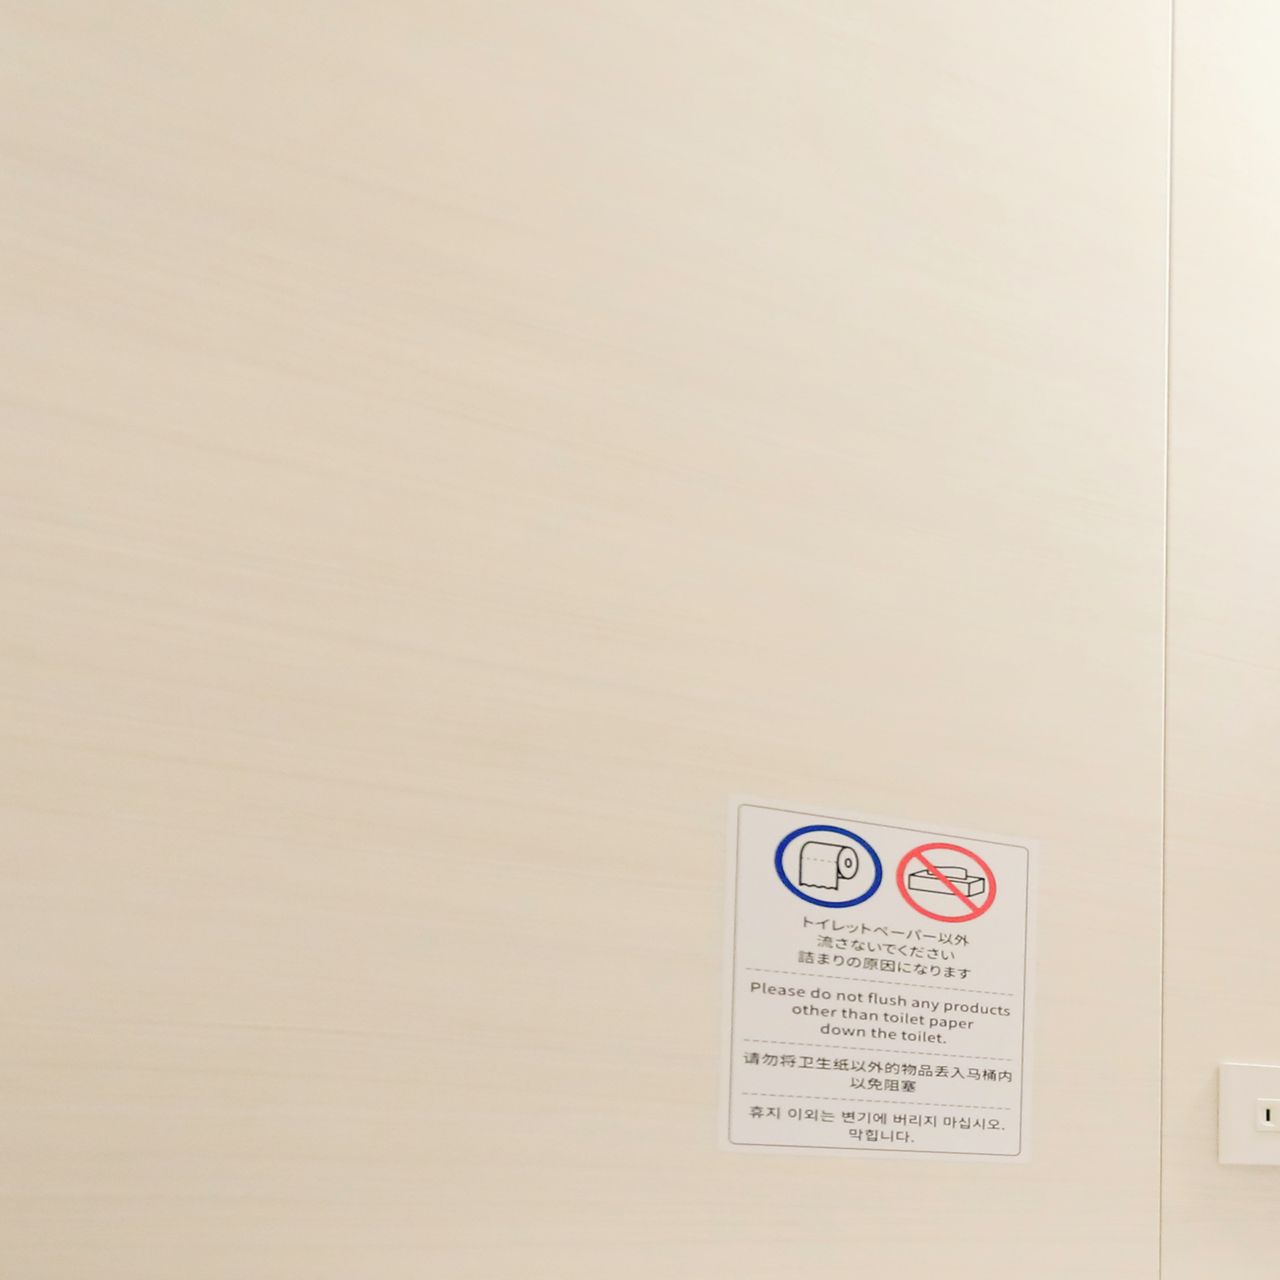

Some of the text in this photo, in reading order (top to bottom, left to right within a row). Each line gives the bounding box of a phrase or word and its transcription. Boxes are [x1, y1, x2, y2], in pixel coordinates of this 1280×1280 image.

[817, 934, 955, 961] 流さないでください
[798, 950, 972, 980] 詰まりの原因になります
[750, 981, 1011, 1017] Please do not flush any products
[791, 1003, 974, 1031] other than toilet paper
[820, 1023, 947, 1044] down the toilet.
[850, 1077, 917, 1093] 以免阻塞
[749, 1105, 1005, 1131] 휴지 이외는 변기에 버리지 마십시오.
[849, 1128, 915, 1143] 막힙니다.
